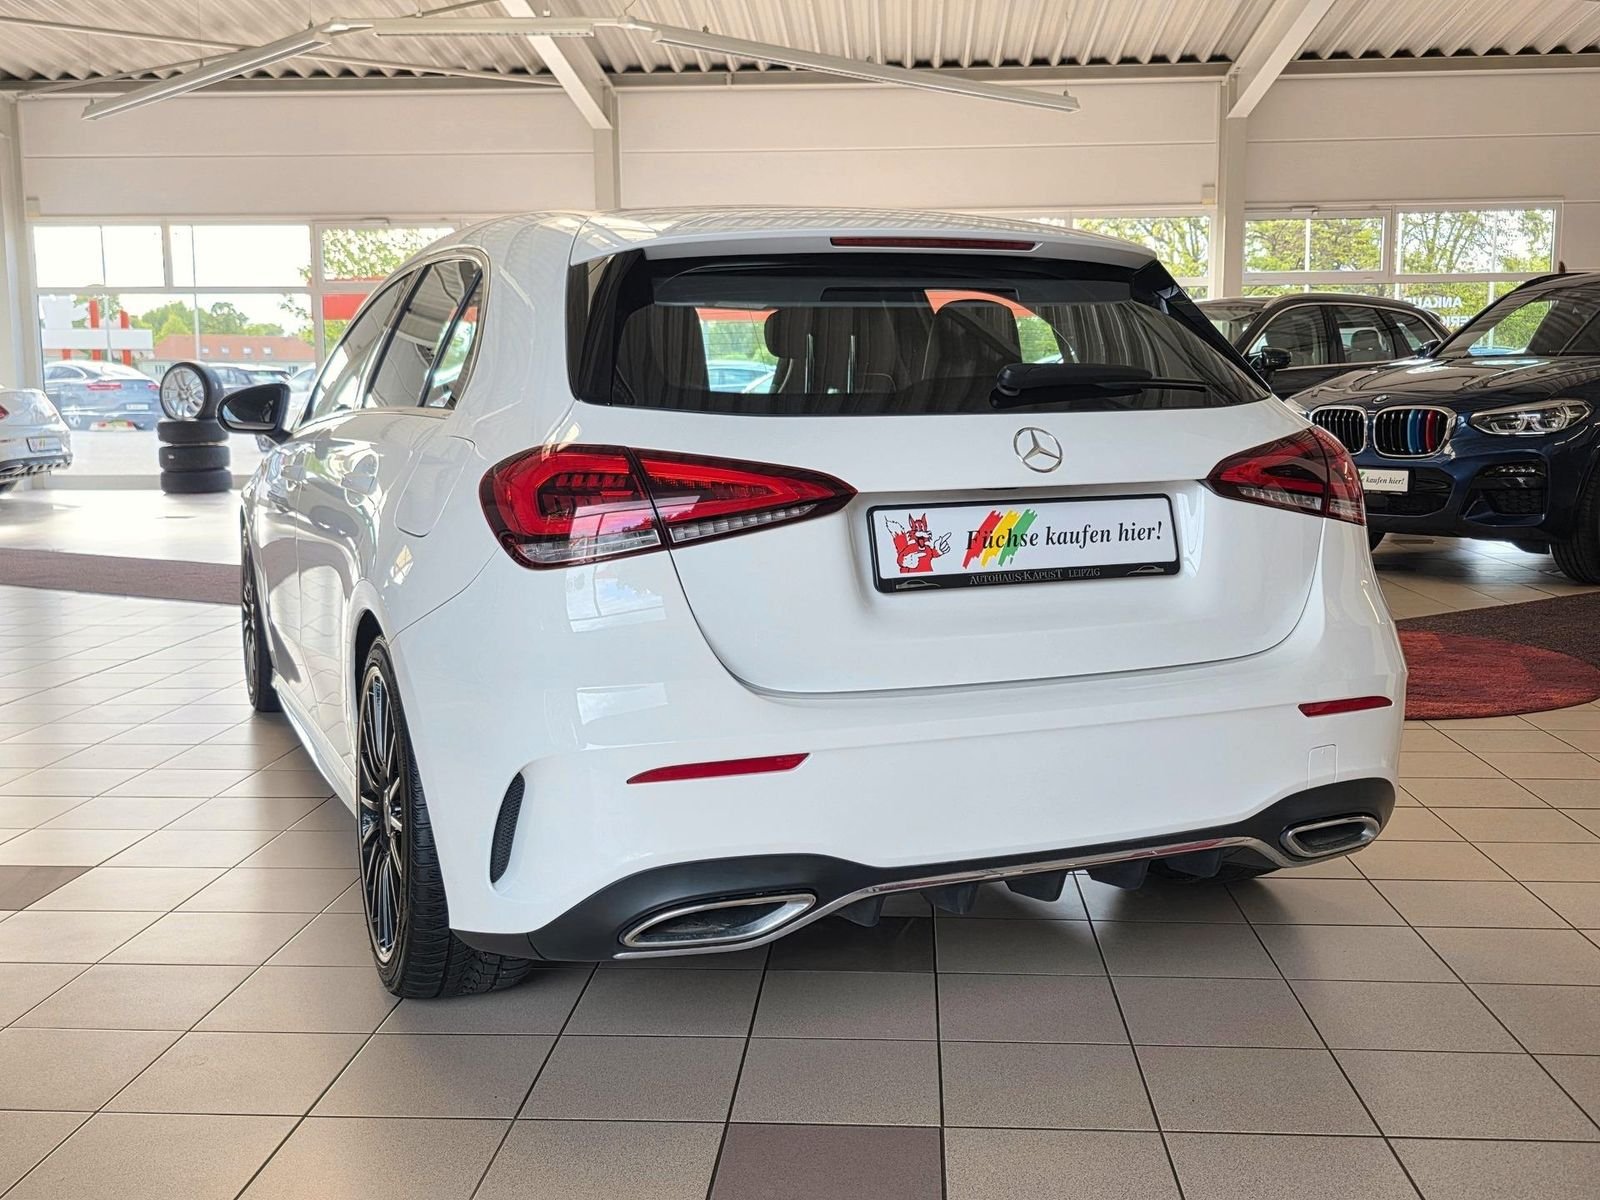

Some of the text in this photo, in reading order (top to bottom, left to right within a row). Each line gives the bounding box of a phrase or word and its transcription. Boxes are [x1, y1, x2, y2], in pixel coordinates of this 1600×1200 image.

[1366, 476, 1388, 485] kaufen
[1389, 477, 1405, 485] hier!
[966, 520, 1162, 550] Füchse kaufen hier!
[1068, 567, 1101, 578] LEIPZIG
